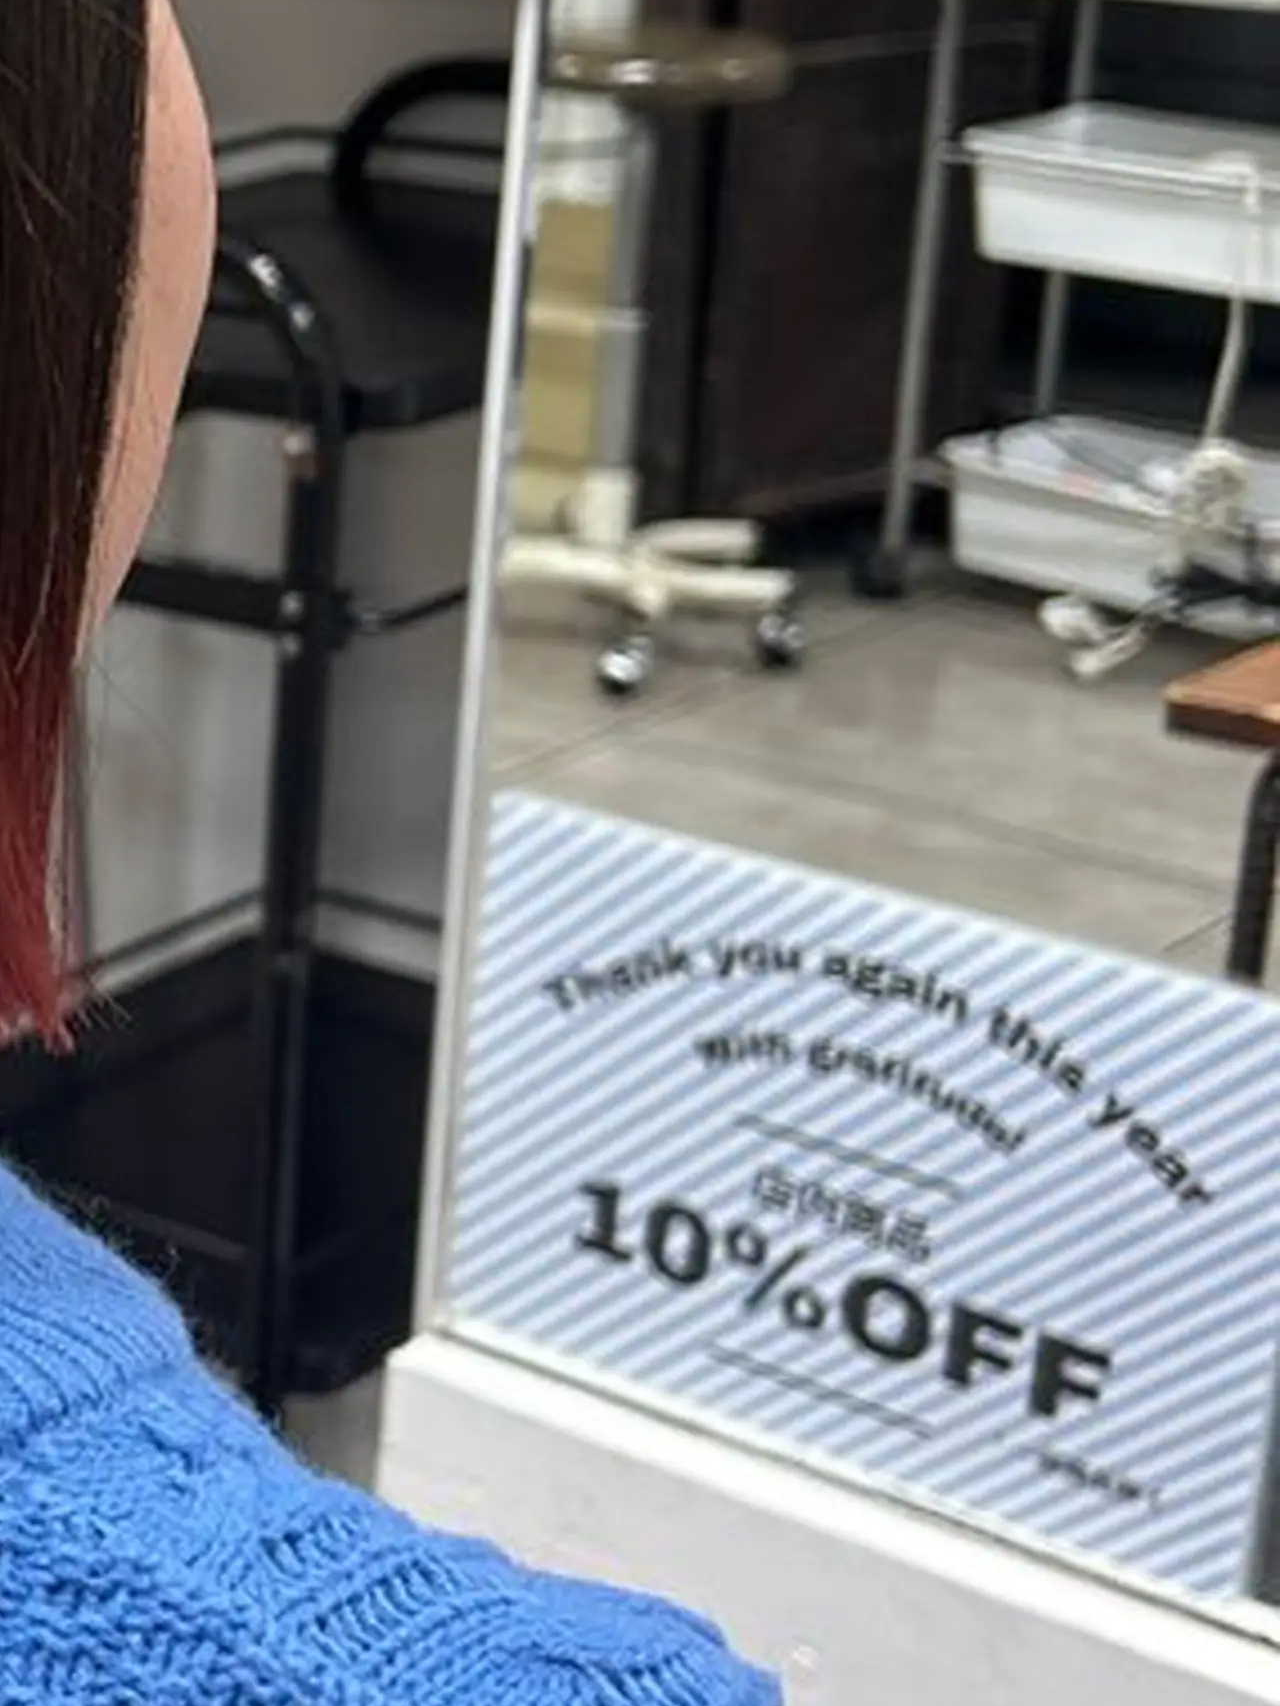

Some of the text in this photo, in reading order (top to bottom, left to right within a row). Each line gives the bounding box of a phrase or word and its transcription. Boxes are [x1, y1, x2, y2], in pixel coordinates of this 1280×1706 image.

[542, 936, 1212, 1206] Thank you again this year
[574, 1180, 1112, 1420] 10%OFF
